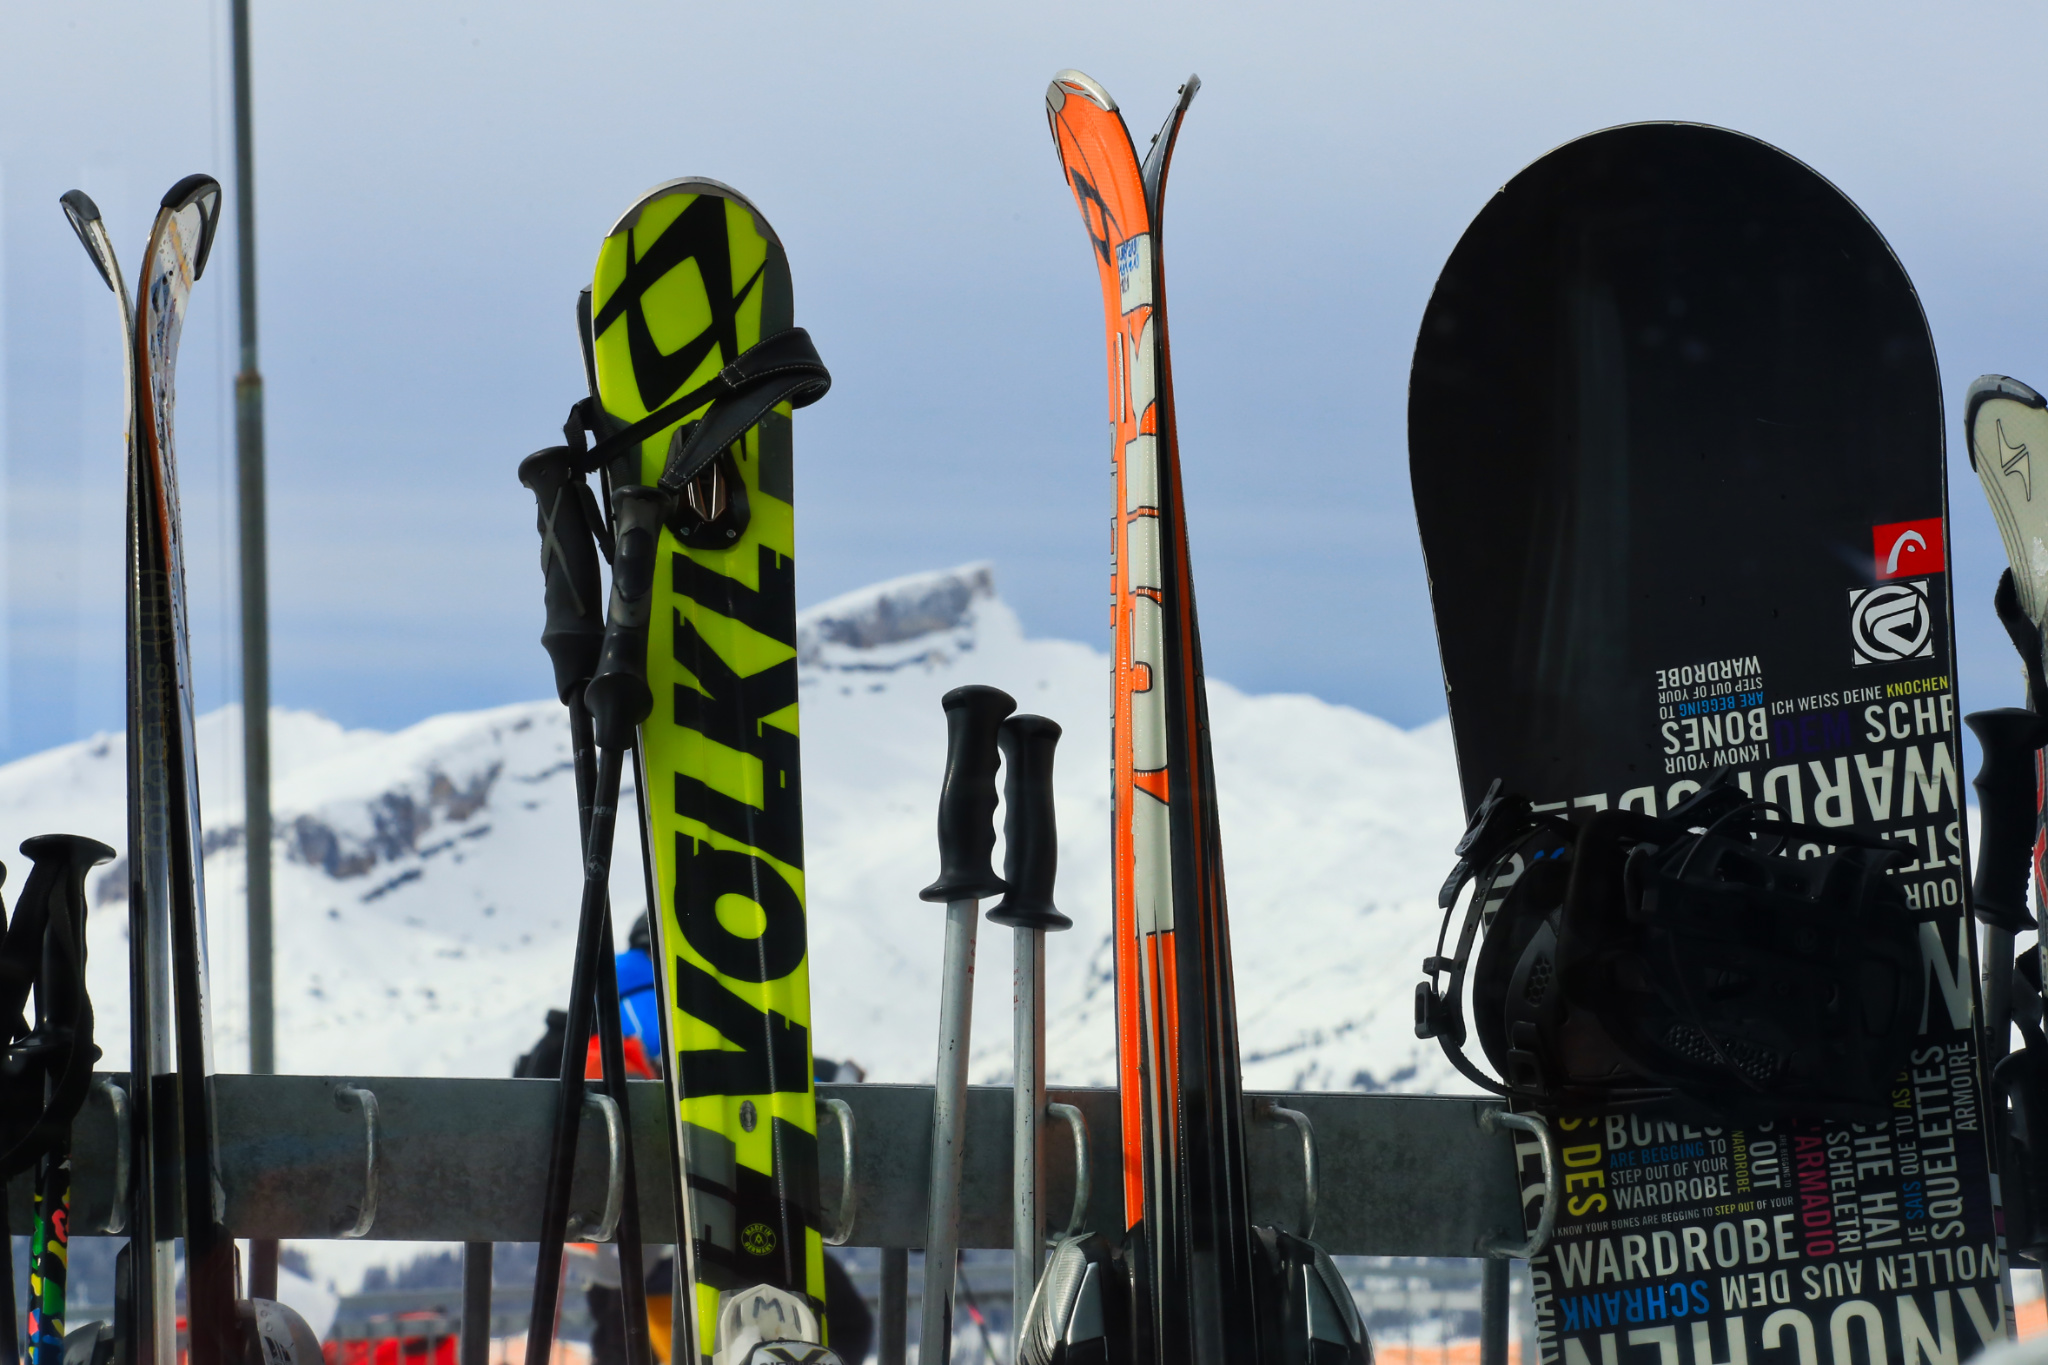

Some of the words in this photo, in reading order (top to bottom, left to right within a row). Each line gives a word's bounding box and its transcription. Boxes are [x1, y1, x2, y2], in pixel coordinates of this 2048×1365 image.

[1656, 655, 1762, 689] WARDROBE
[1735, 677, 1763, 691] STEP
[1658, 688, 1689, 704] YOUR
[1693, 685, 1707, 698] OF
[1709, 681, 1732, 696] OUT
[1740, 691, 1764, 706] ARE
[1771, 699, 1794, 715] ICH
[1798, 692, 1840, 712] WEISS
[1843, 685, 1883, 705] DEINE
[1886, 675, 1948, 698] KNOCHEN
[1659, 704, 1675, 720] TO
[1679, 695, 1736, 717] BEGGING
[1661, 707, 1769, 755] BONES
[1773, 710, 1852, 757] DEM
[1665, 752, 1709, 774] YOUR
[1714, 744, 1760, 767] KNOW
[1765, 743, 1771, 759] I
[1891, 1087, 1912, 1109] AS
[1947, 1041, 1978, 1131] ARMOIRE
[1895, 1114, 1915, 1138] TU
[1610, 1152, 1636, 1169] ARE
[1642, 1141, 1704, 1164] BEGGING
[1708, 1138, 1727, 1155] TO
[1897, 1141, 1920, 1176] QUE
[1910, 1045, 1965, 1240] SQUELETTES
[1611, 1167, 1642, 1186] STEP
[1645, 1163, 1671, 1181] OUT
[1673, 1161, 1689, 1177] OF
[1694, 1156, 1728, 1175] YOUR
[1749, 1140, 1781, 1189] OUT
[1780, 1147, 1791, 1178] BEGGING
[1561, 1143, 1608, 1216] DES
[1612, 1173, 1731, 1211] WARDROBE
[1825, 1130, 1863, 1254] SCHELETRI
[1558, 1224, 1582, 1238] KNOW
[1585, 1221, 1609, 1234] YOUR
[1611, 1216, 1640, 1230] BONES
[1642, 1213, 1659, 1227] ARE
[1661, 1208, 1700, 1223] BEGGING
[1702, 1206, 1714, 1218] TO
[1715, 1202, 1737, 1217] STEP
[1738, 1200, 1755, 1213] OUT
[1756, 1199, 1768, 1211] OF
[1770, 1195, 1794, 1209] YOUR
[1902, 1181, 1925, 1220] SAIS
[744, 1224, 764, 1237] MADE
[1860, 1191, 1902, 1250] HAI
[1908, 1225, 1928, 1242] JE
[744, 1241, 773, 1254] GERMANY
[1553, 1213, 1800, 1288] WARDROBE
[1720, 1268, 1791, 1312] DEM
[1804, 1258, 1862, 1301] AUS
[1559, 1279, 1710, 1332] SCHRANK
